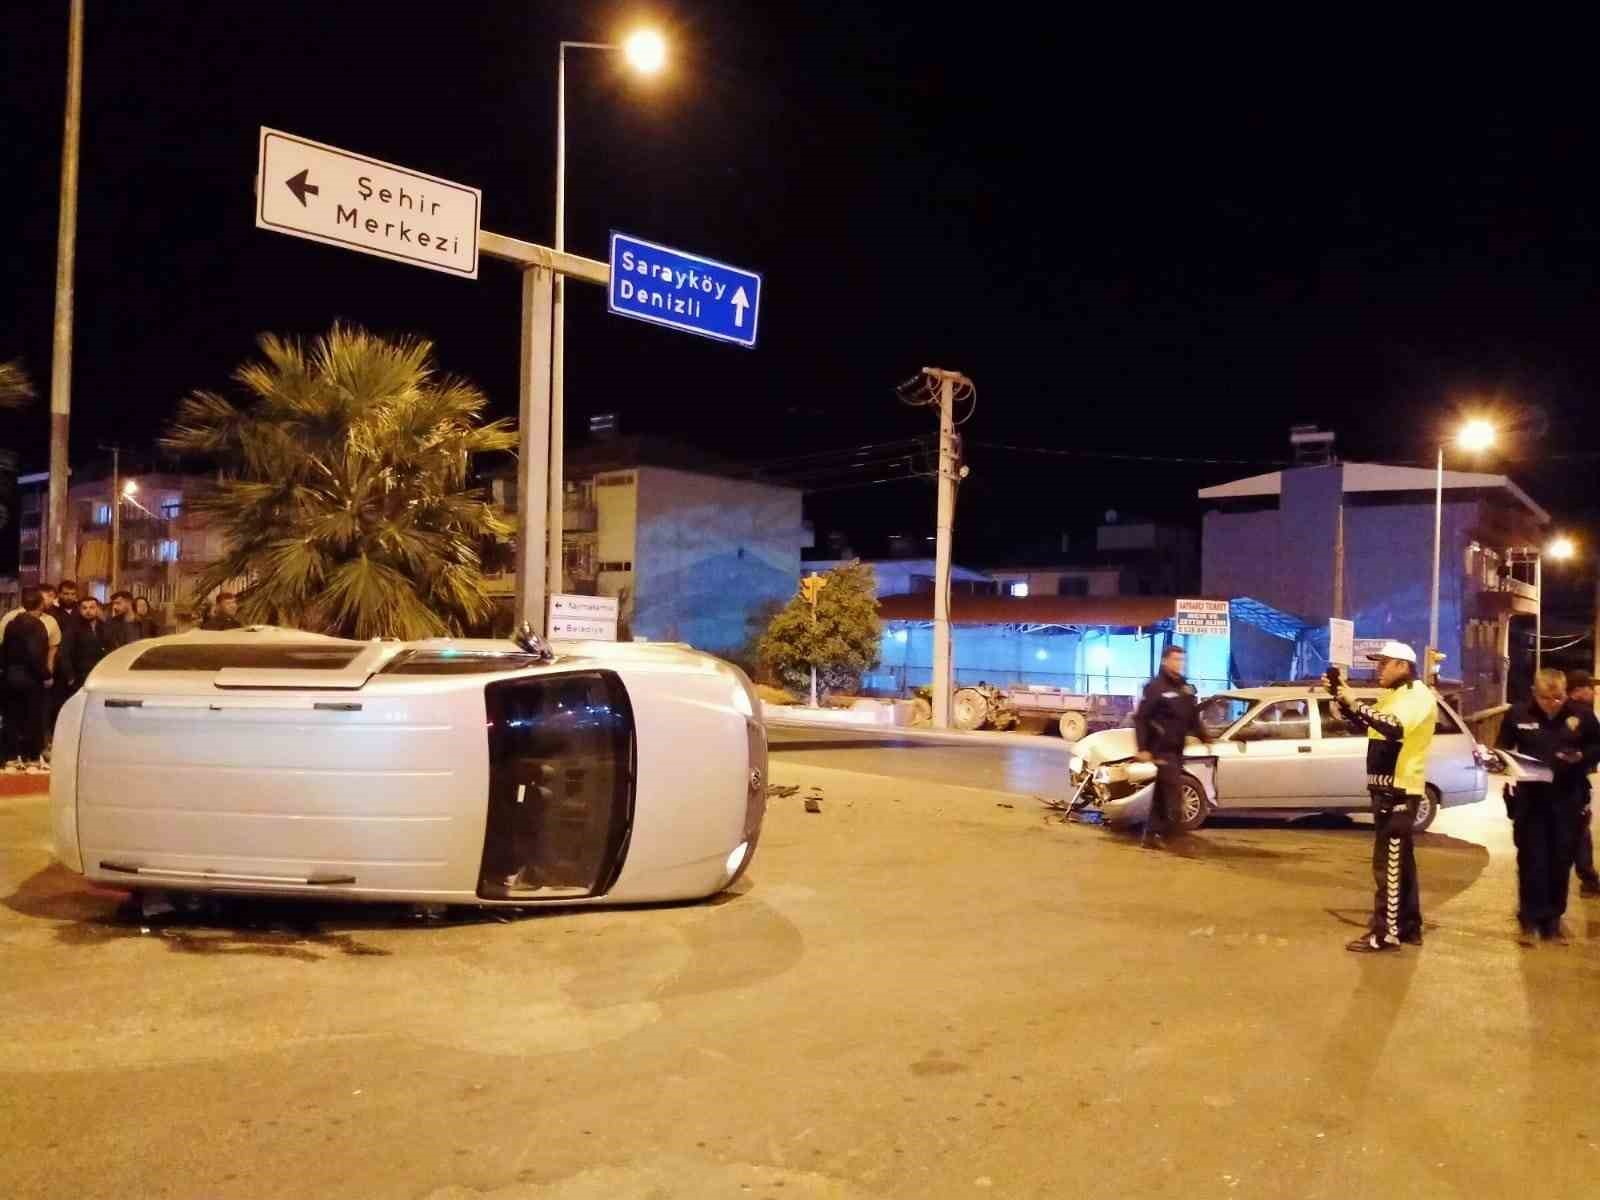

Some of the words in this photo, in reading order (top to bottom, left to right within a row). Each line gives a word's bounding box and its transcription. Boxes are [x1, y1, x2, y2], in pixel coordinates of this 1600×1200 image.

[357, 176, 441, 216] Şehir
[336, 204, 459, 254] Merkezi
[622, 251, 726, 300] Sarayköy
[621, 279, 700, 318] Denizli
